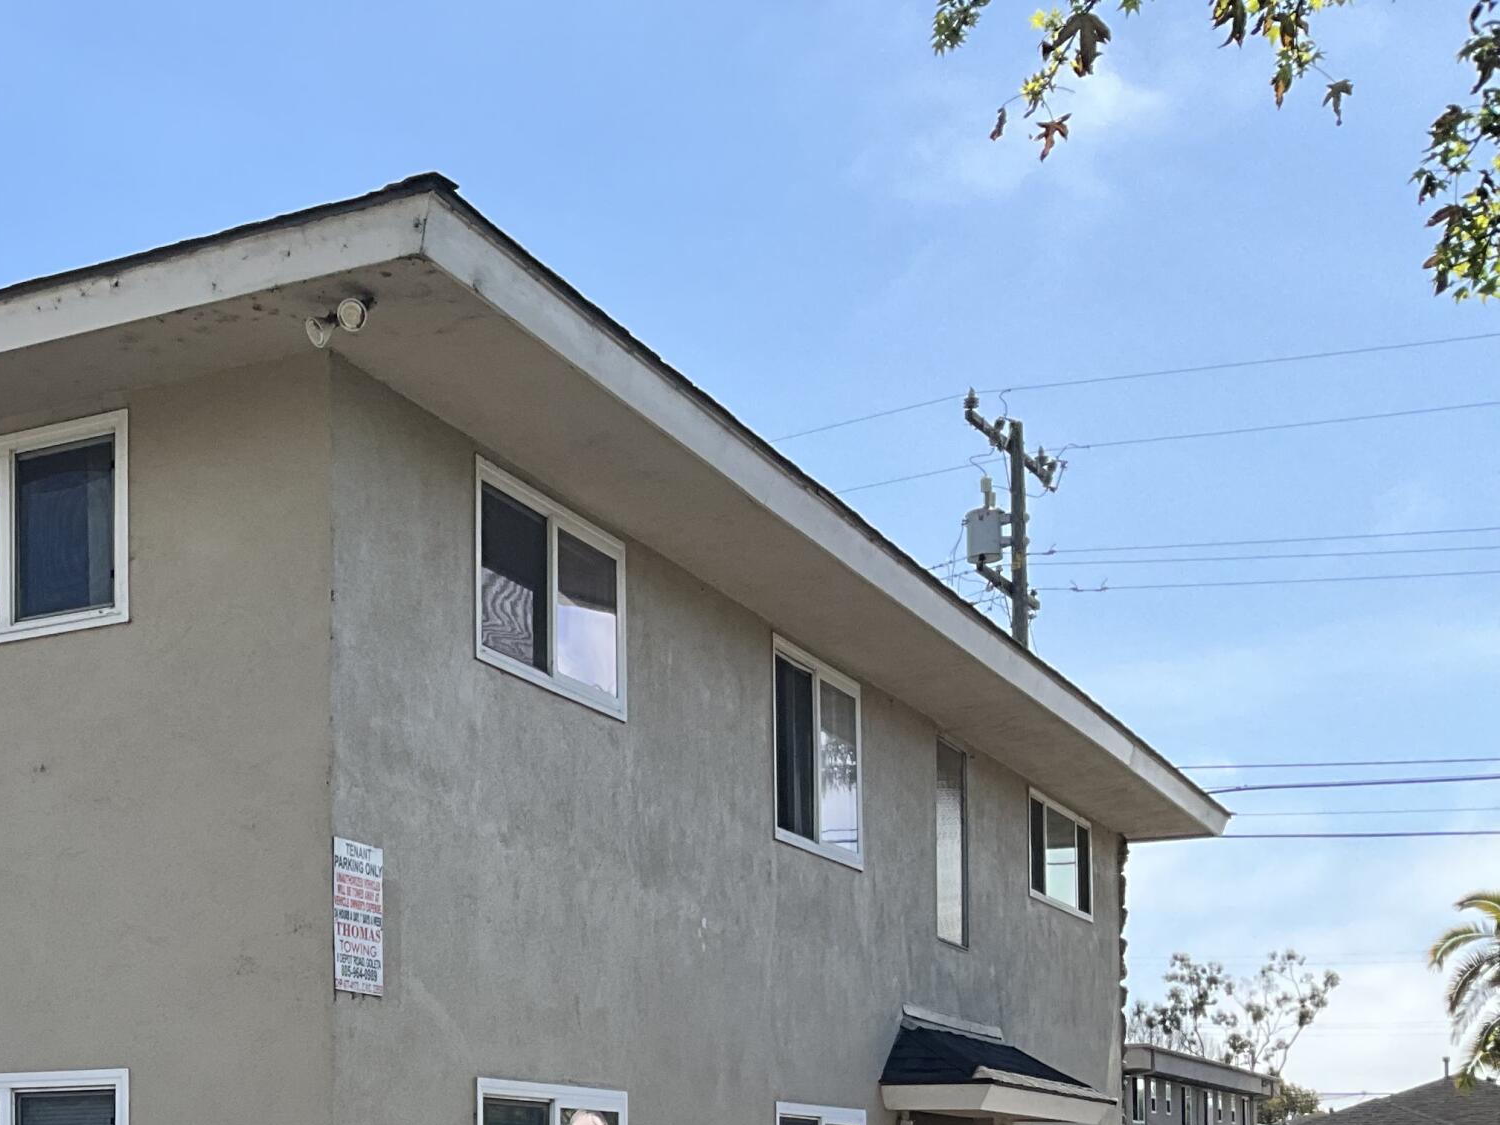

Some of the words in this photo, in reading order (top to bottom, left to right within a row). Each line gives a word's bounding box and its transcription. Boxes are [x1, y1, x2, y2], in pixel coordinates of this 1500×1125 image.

[346, 843, 371, 861] TENANT
[335, 855, 364, 873] PARKING
[365, 862, 383, 878] ONLY
[337, 922, 381, 943] THOMAS
[340, 940, 376, 957] TOWING
